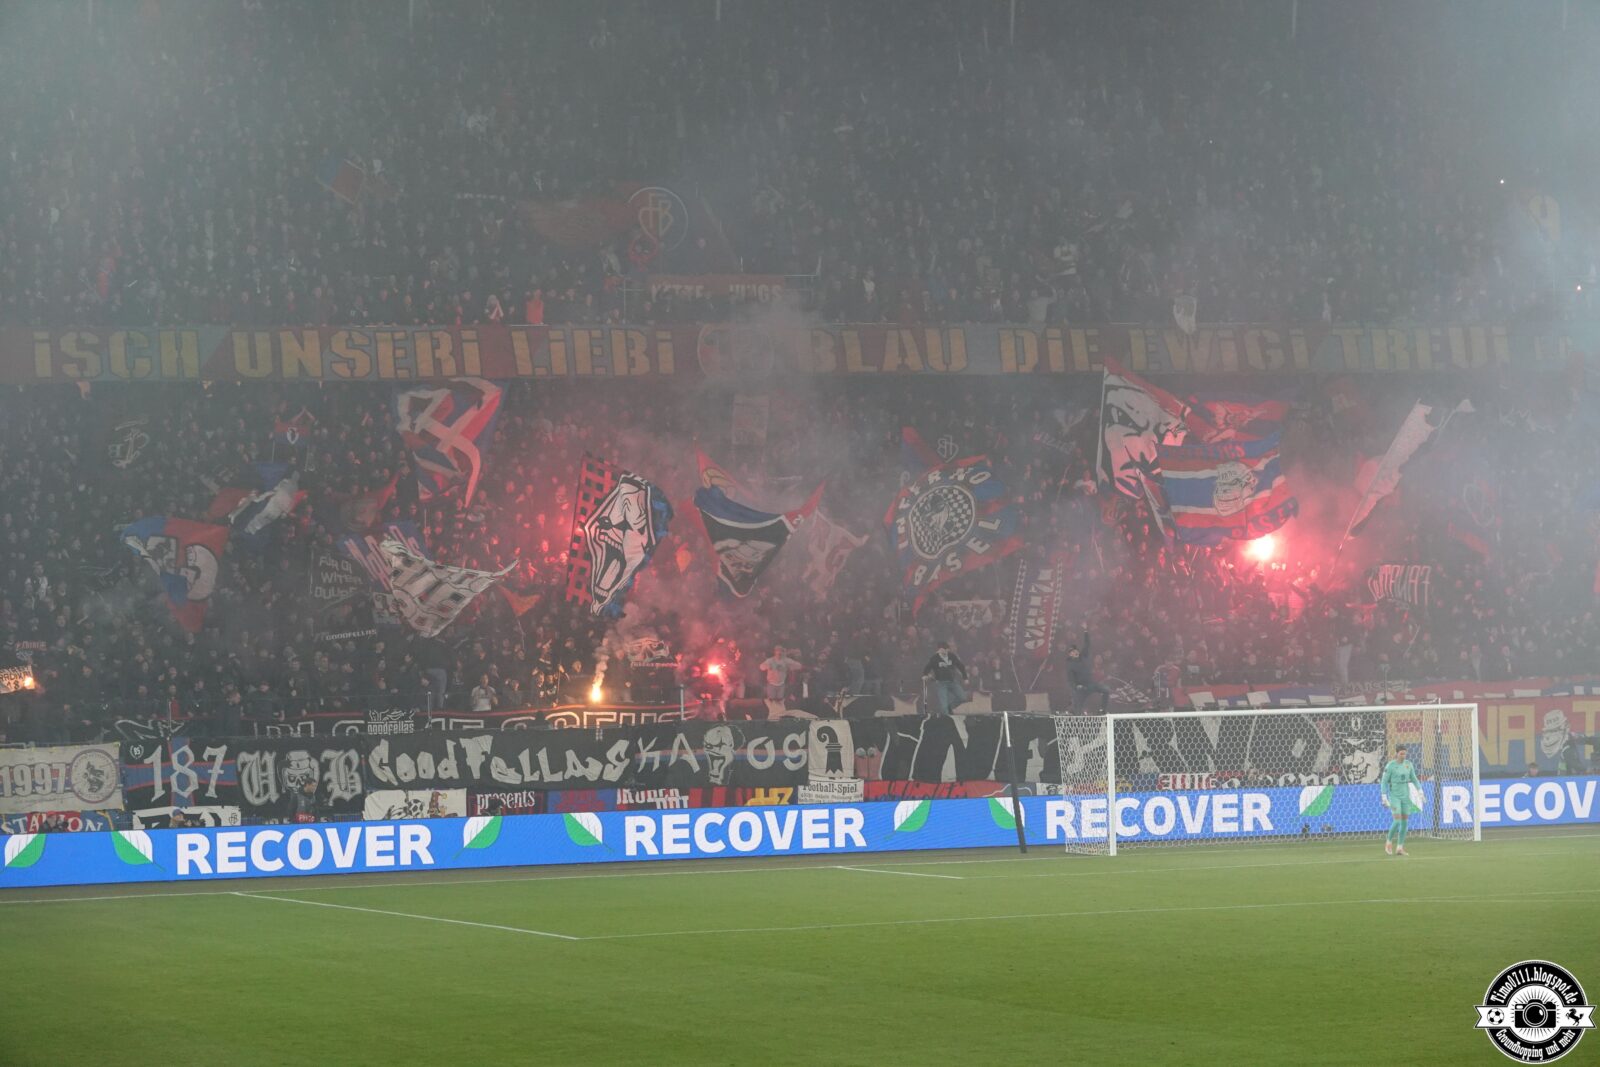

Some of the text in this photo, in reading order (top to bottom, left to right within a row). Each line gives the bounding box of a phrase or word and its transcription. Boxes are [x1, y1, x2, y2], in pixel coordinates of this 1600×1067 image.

[0, 762, 66, 798] 1997
[143, 744, 229, 804] 187
[475, 789, 536, 815] prsents
[1046, 792, 1274, 841] RECOVER
[1442, 780, 1597, 825] RECOV
[177, 823, 434, 876] RECOVER
[625, 808, 868, 857] RECOVER
